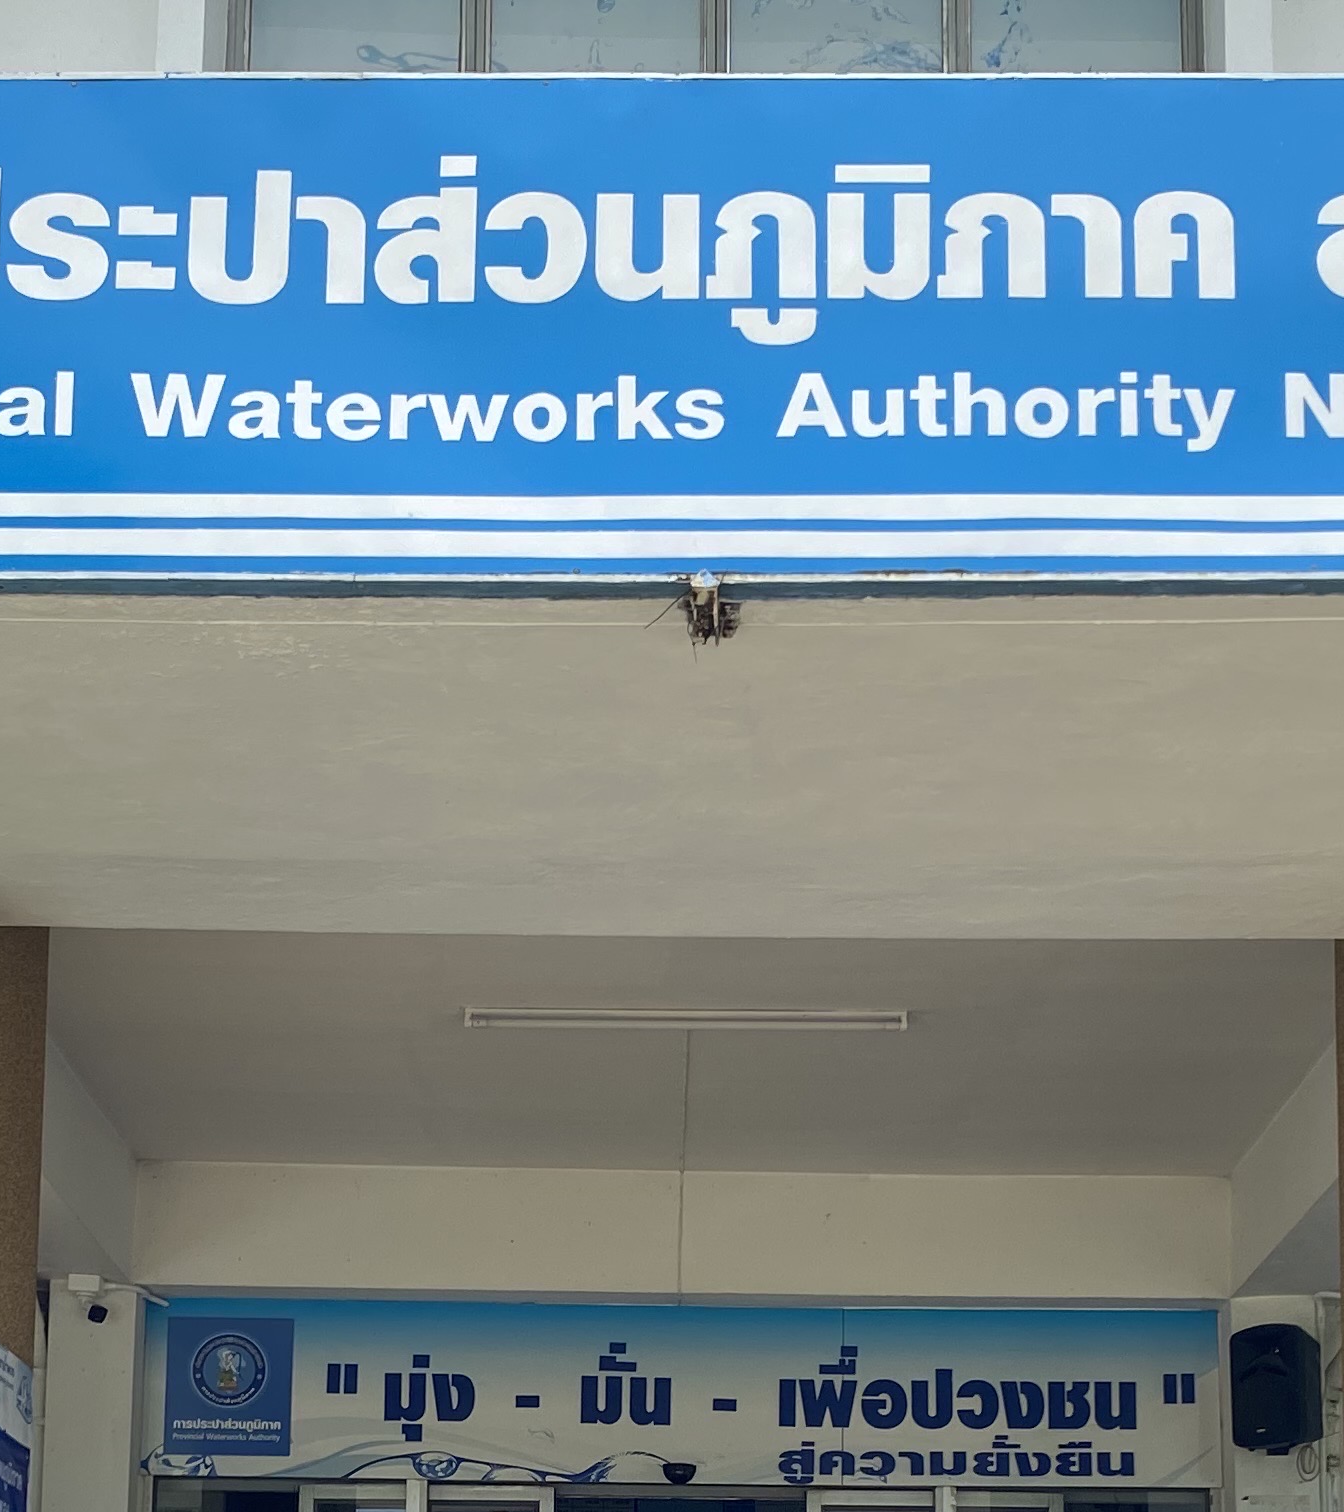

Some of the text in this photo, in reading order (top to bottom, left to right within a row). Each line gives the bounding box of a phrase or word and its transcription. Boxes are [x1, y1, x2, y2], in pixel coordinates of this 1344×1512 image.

[130, 372, 726, 443] Waterworks
[775, 371, 1237, 453] Authority
[382, 1354, 475, 1442] มุ่ง
[579, 1341, 672, 1426] มั่น
[777, 1345, 1138, 1431] เพื่อปวงชน
[172, 1417, 282, 1432] การประปาส่วนภูมิภาค
[777, 1435, 1136, 1484] สู่ความยั่งยืน
